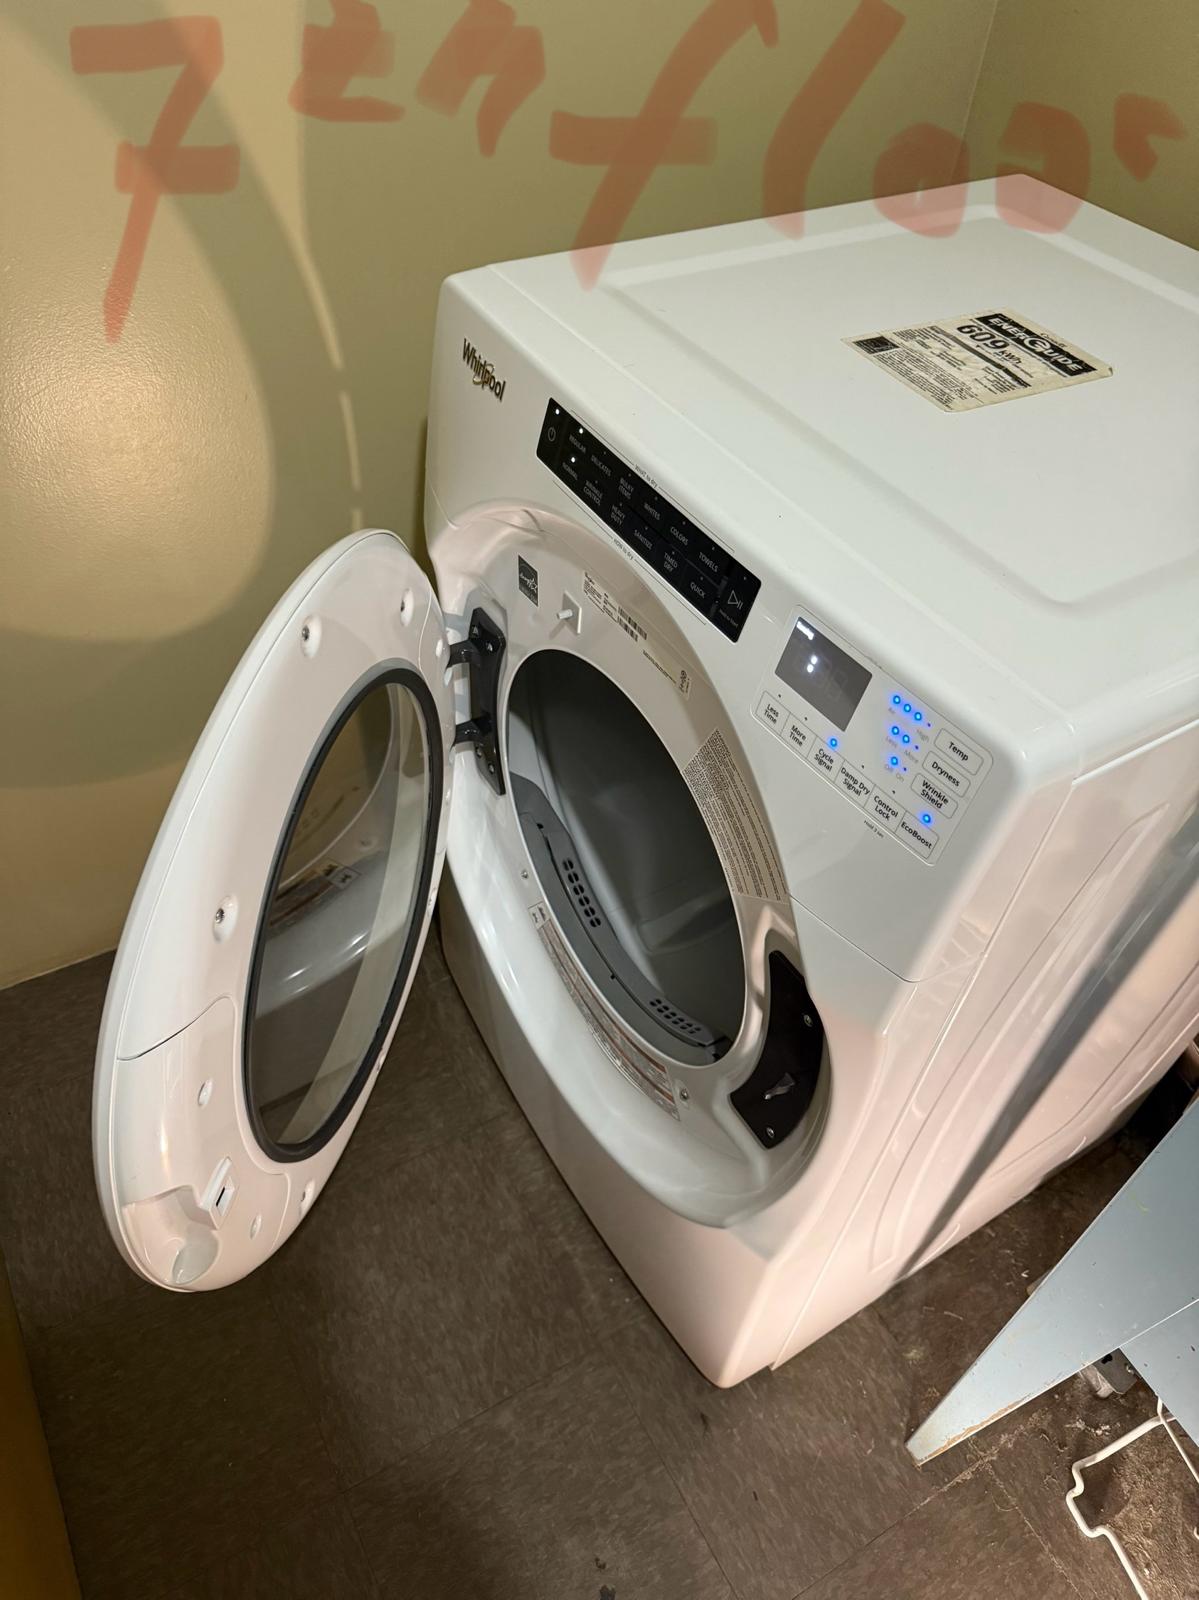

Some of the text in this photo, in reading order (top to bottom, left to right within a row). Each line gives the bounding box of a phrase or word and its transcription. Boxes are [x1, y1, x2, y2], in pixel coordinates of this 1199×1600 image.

[956, 324, 1010, 351] 609
[995, 349, 1023, 364] kWh
[462, 338, 506, 402] Whirlpool
[583, 486, 600, 506] CONTROL
[611, 504, 625, 519] HEAVY
[644, 502, 661, 520] WHITES
[634, 529, 652, 549] SANITIZE
[670, 526, 688, 546] COLORS
[663, 561, 674, 572] DRY
[664, 552, 678, 568] TIMED
[699, 552, 718, 572] TOWELS
[690, 581, 706, 599] QUICK
[764, 710, 777, 724] Time
[766, 704, 779, 717] Less
[789, 732, 803, 747] Time
[791, 725, 807, 741] More
[818, 748, 834, 765] Cycle
[948, 741, 969, 761] Temp
[814, 754, 833, 772] Signal
[840, 767, 871, 795] Damp Dry
[931, 761, 960, 787] Dryness
[842, 778, 861, 796] Signal
[921, 780, 949, 805] Wrinkle
[873, 795, 898, 818] Control
[920, 789, 943, 809] Shield
[874, 806, 890, 821] Lock
[900, 821, 932, 849] EcoBoost
